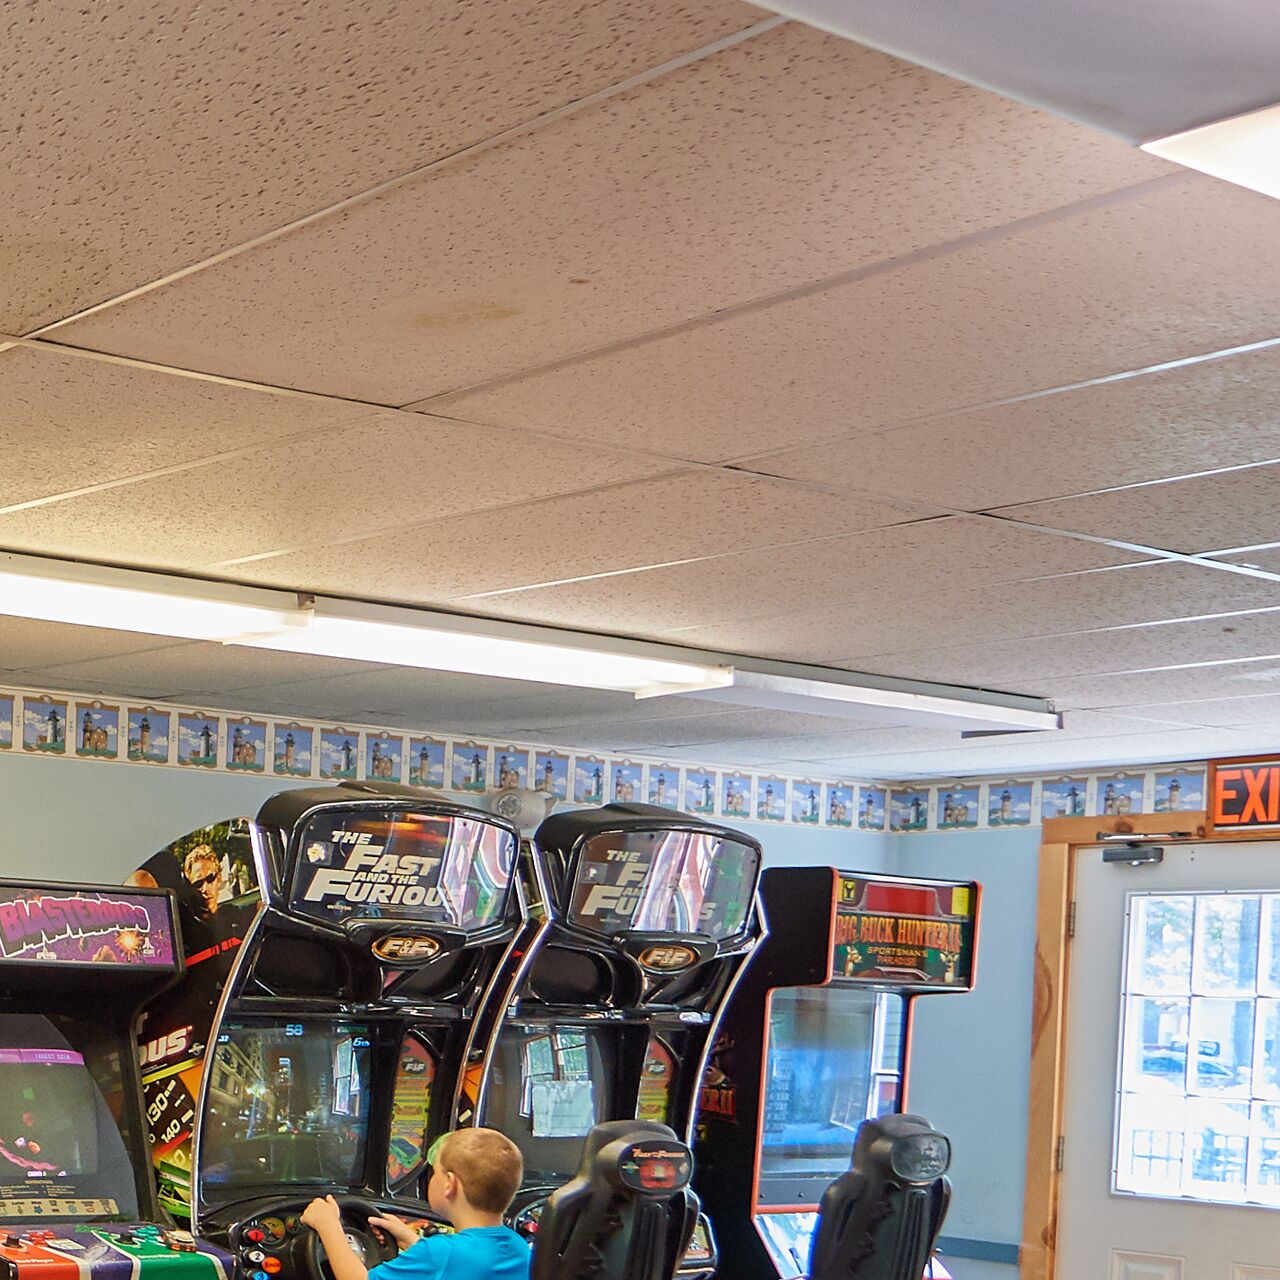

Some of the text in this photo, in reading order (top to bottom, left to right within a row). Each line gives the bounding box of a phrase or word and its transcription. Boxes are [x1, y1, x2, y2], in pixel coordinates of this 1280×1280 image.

[1214, 767, 1280, 824] EXI
[331, 830, 373, 845] THE
[344, 845, 442, 876] FAST
[607, 850, 641, 862] THE
[354, 872, 420, 885] AND THE
[835, 915, 857, 944] BIG
[860, 916, 895, 943] BUCK
[897, 919, 948, 951] HUNTER
[382, 936, 434, 957] F&F
[867, 946, 928, 958] SPORTSMAN'S
[647, 949, 687, 966] F&F
[877, 955, 917, 967] PARADISE
[285, 1024, 303, 1036] 58
[160, 1118, 181, 1143] 140
[254, 1252, 262, 1261] 2
